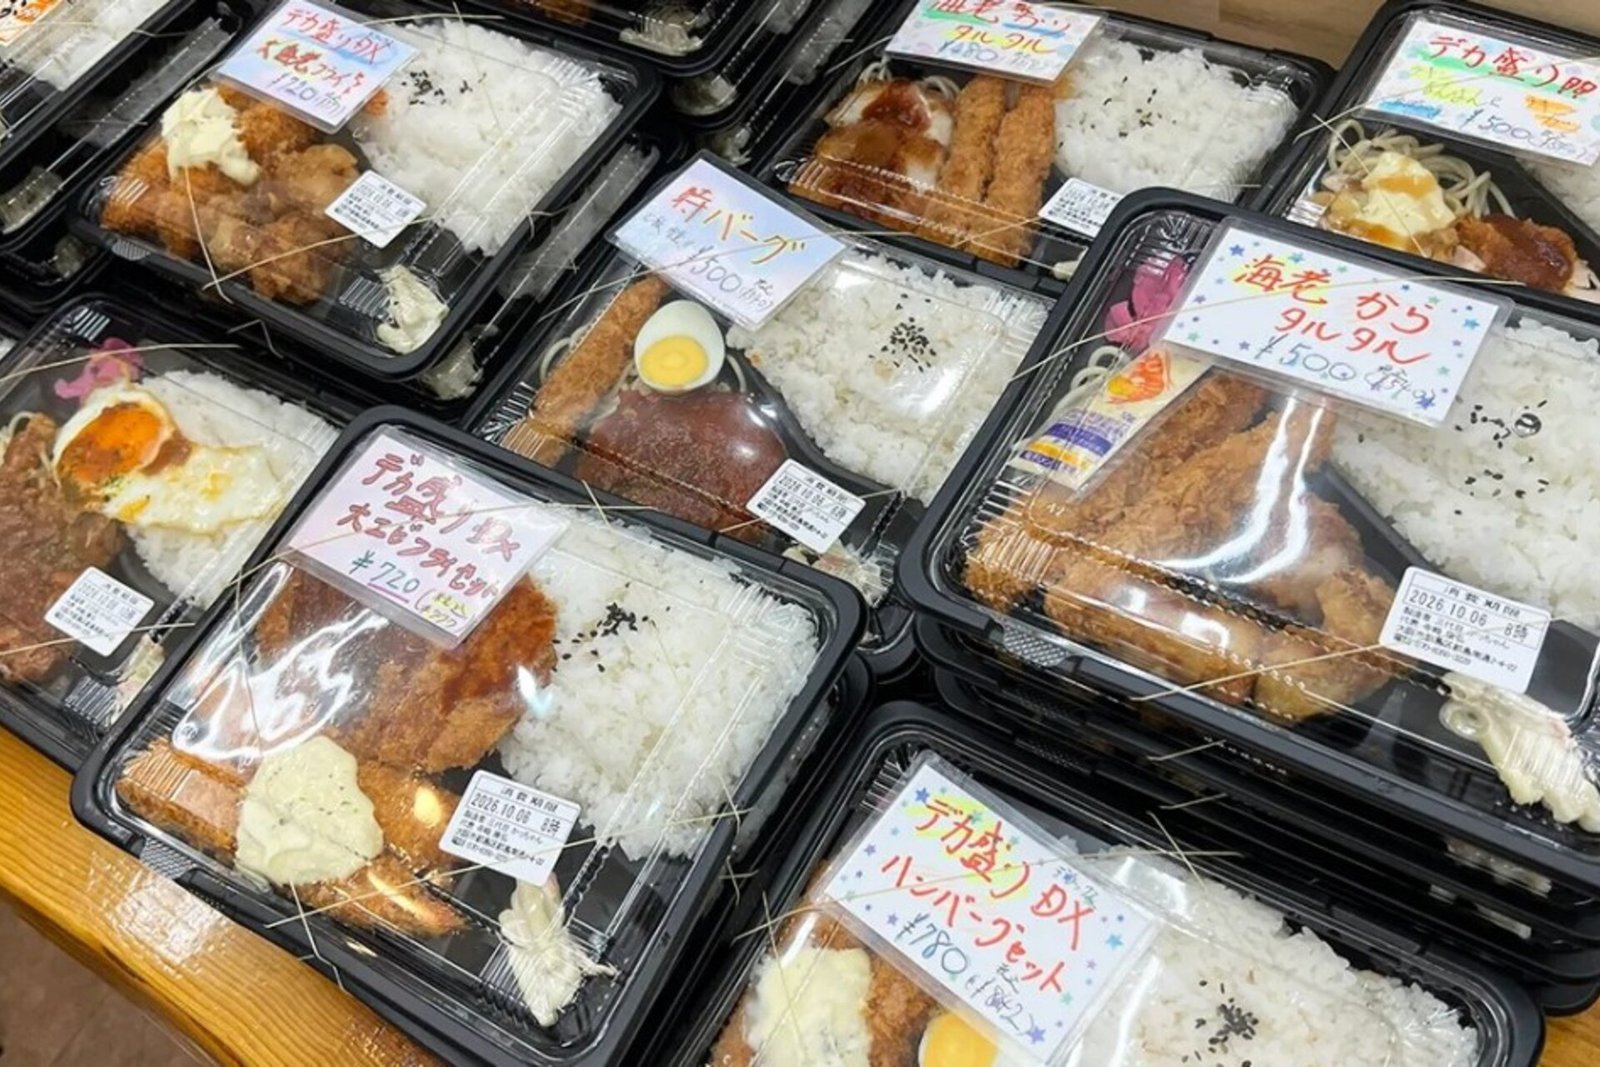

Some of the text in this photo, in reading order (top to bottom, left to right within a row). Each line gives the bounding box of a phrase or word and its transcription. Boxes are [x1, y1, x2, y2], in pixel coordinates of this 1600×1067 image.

[881, 855, 1066, 993] ハンバーグセット
